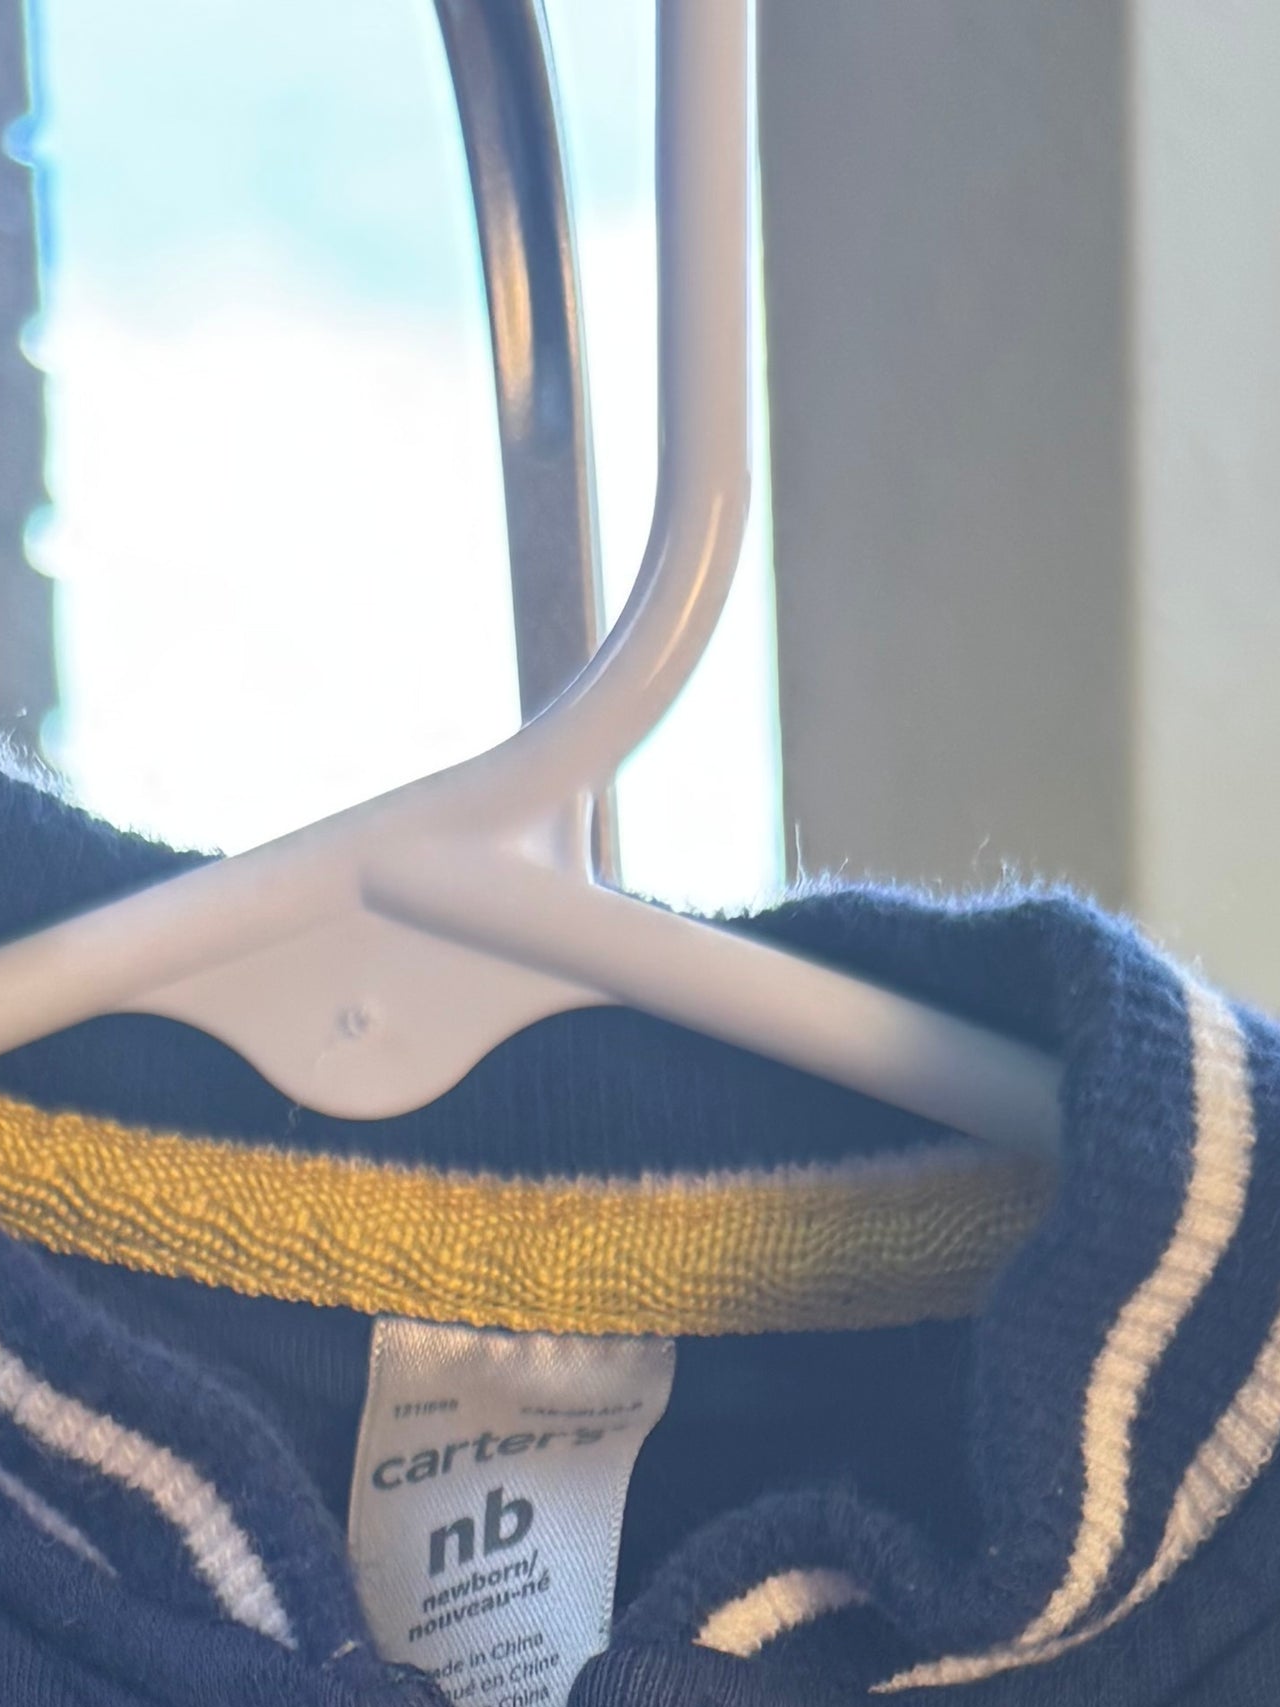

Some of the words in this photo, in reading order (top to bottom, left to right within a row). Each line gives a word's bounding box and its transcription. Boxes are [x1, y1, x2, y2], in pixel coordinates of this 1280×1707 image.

[429, 1484, 535, 1576] nb
[408, 1569, 551, 1643] nouveau-né
[422, 1549, 539, 1615] newborn/
[469, 1653, 487, 1668] in
[492, 1632, 544, 1660] China
[481, 1674, 505, 1693] en
[510, 1653, 561, 1682] Chine
